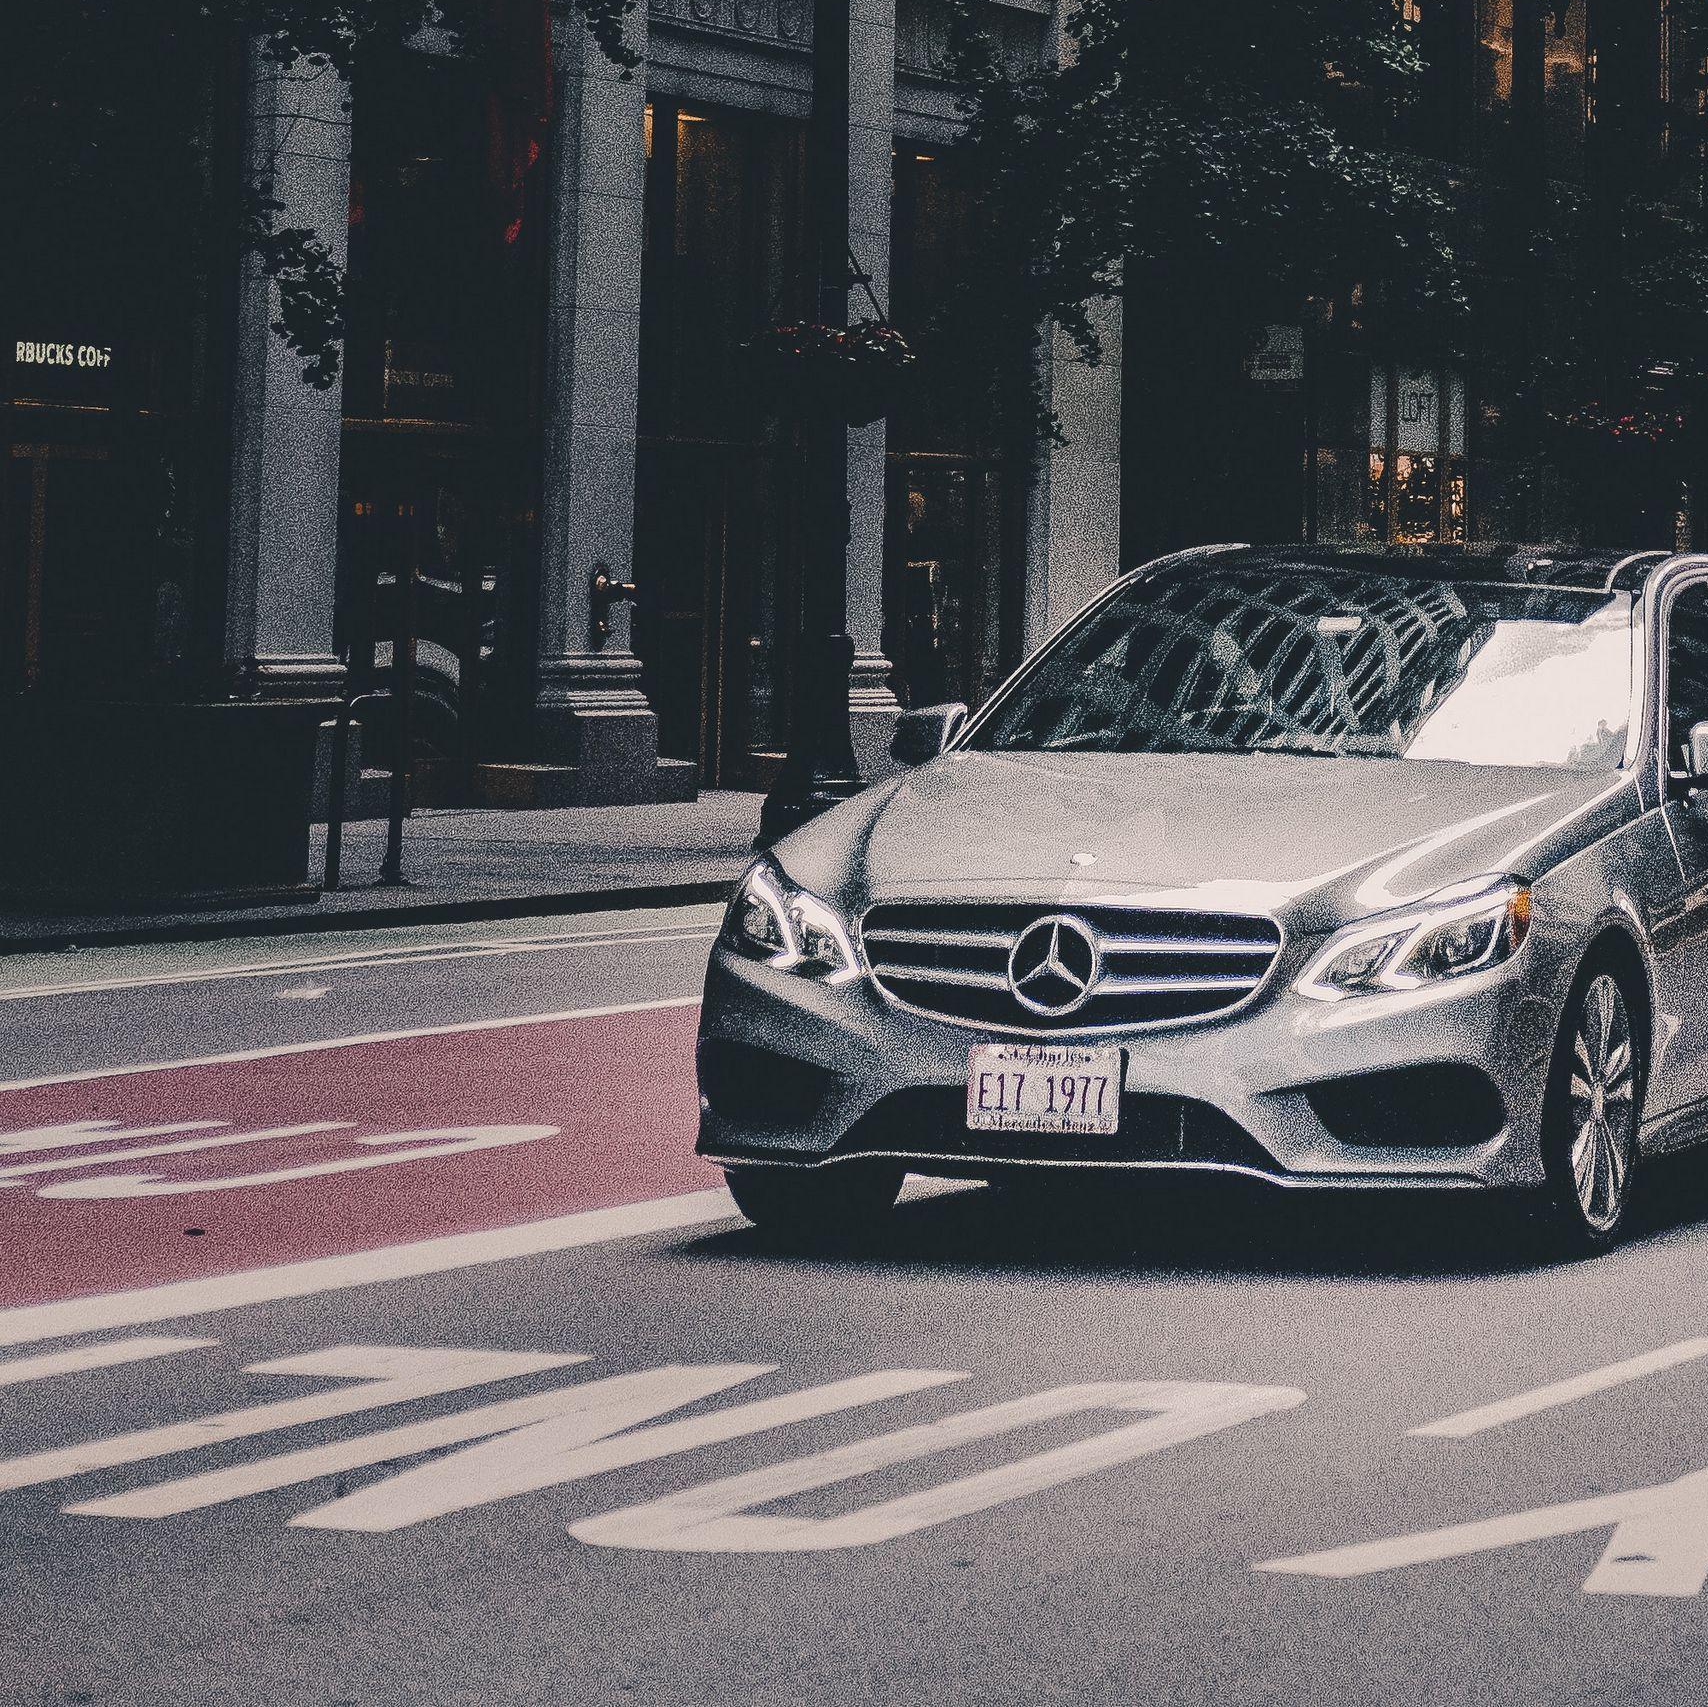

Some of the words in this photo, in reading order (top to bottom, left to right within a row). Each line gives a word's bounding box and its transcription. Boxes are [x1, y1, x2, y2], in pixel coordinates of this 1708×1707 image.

[15, 341, 74, 366] RBUCKS
[977, 1072, 1026, 1112] E17
[1044, 1075, 1109, 1116] 1977
[0, 1335, 1306, 1555] ONL
